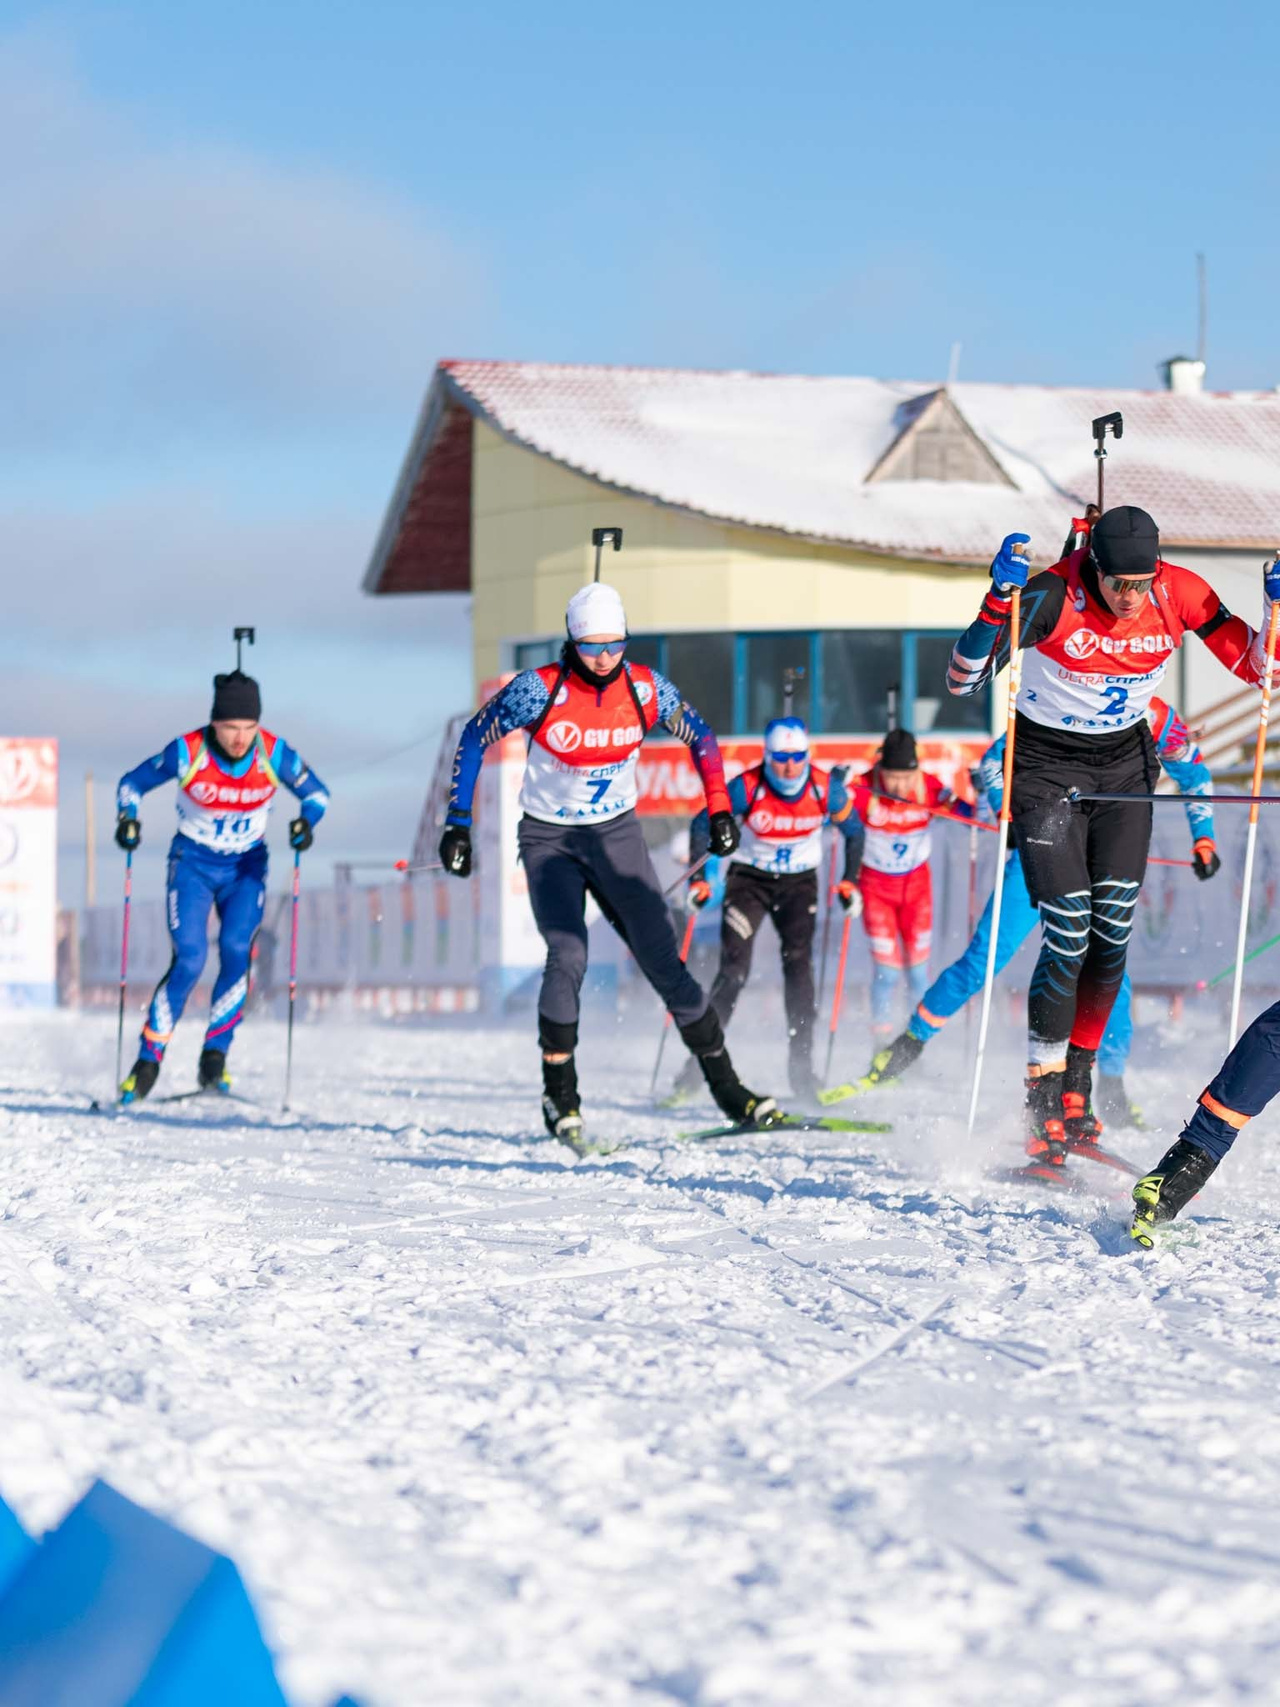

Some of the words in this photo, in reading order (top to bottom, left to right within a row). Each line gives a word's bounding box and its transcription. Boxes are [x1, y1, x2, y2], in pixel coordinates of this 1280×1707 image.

[1101, 636, 1127, 654] GV
[1130, 634, 1174, 654] GOLD
[1026, 689, 1038, 702] 2
[1096, 686, 1128, 716] 2
[584, 729, 609, 747] GV
[612, 726, 643, 746] GOL
[586, 779, 613, 804] 7
[213, 817, 251, 836] 10
[775, 847, 792, 864] 8
[893, 843, 908, 859] 9
